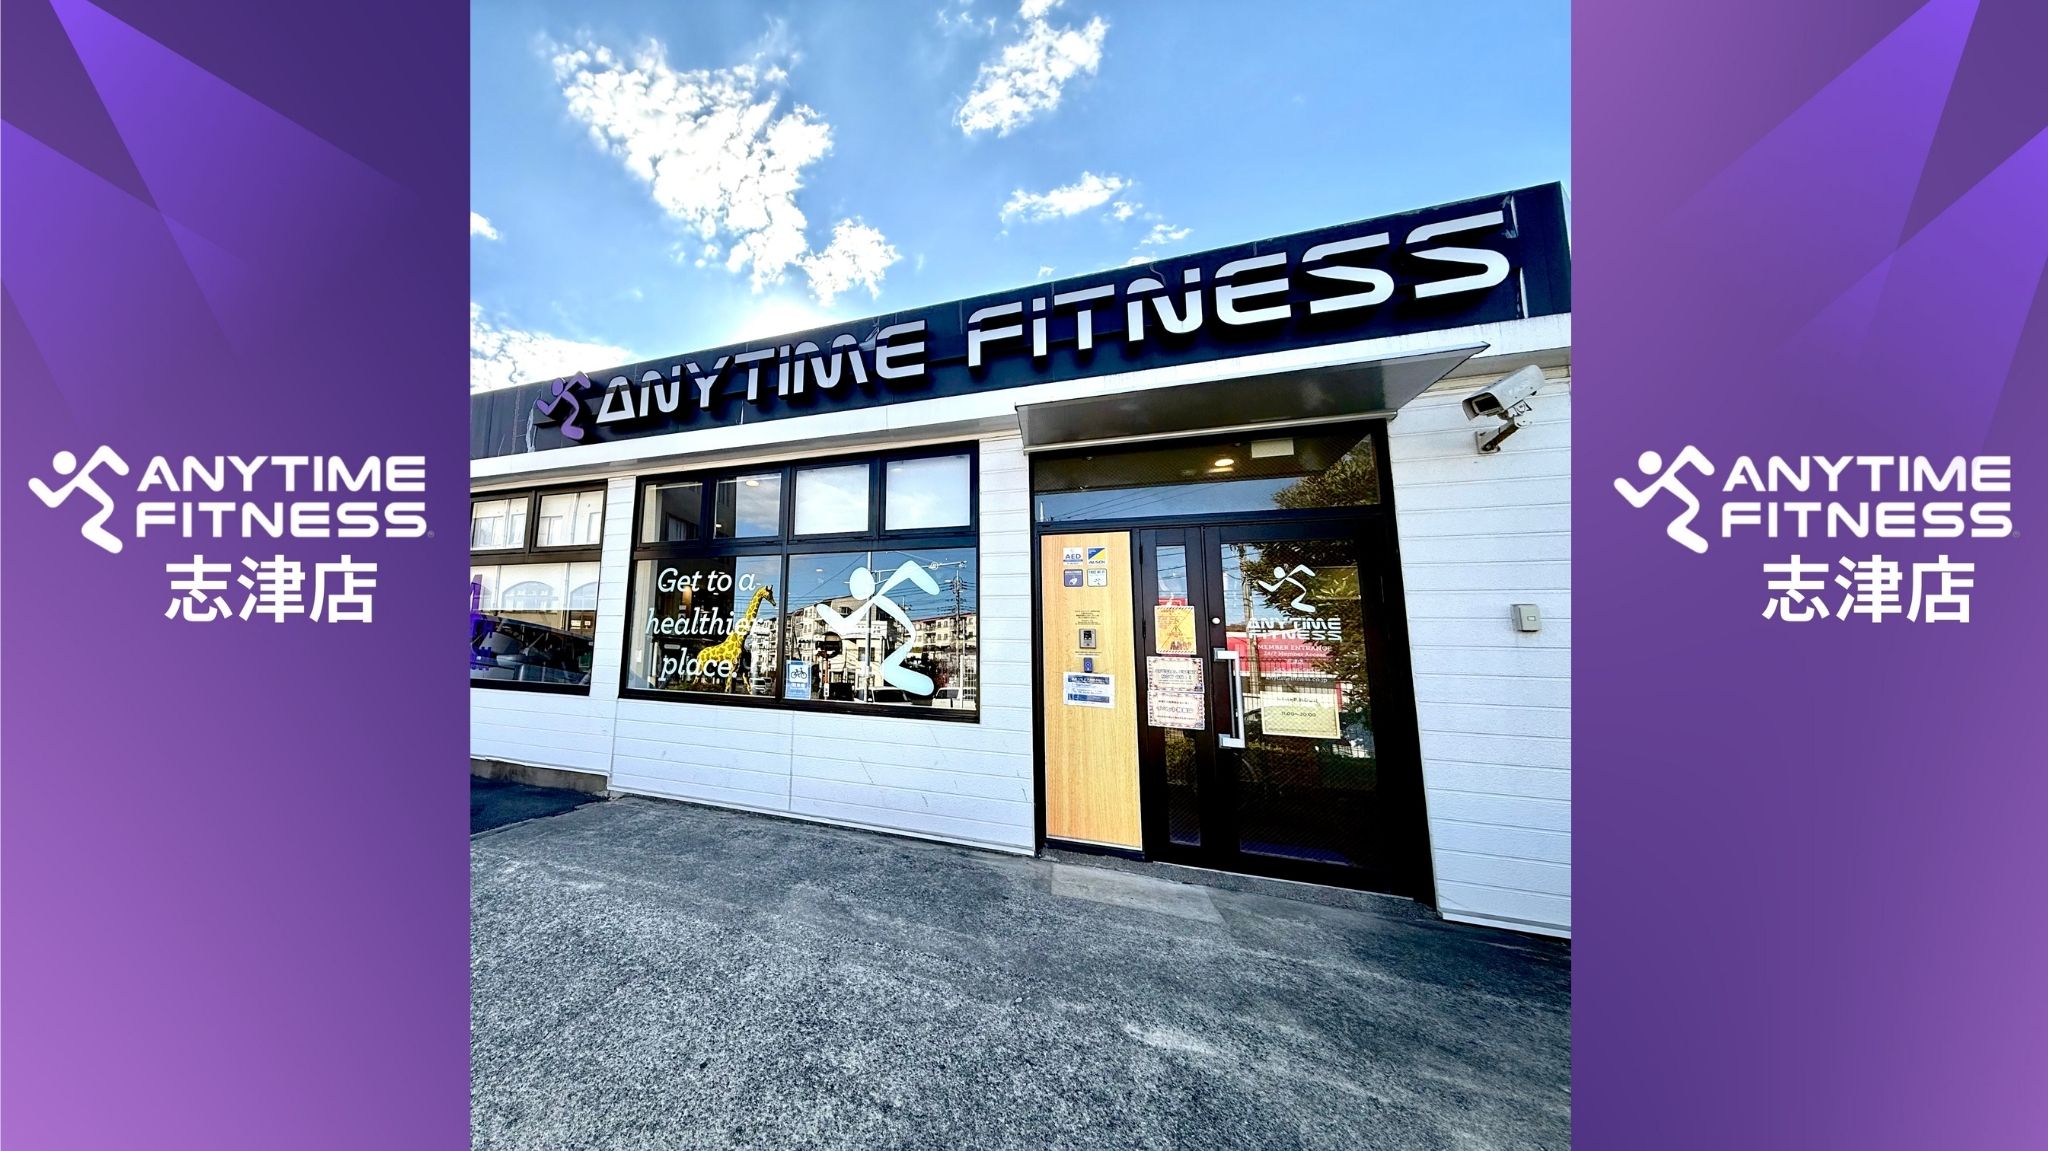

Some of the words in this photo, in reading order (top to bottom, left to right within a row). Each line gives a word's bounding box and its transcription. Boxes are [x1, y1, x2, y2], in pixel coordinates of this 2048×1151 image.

[595, 319, 926, 424] ANYTIME
[967, 210, 1511, 367] FITNESS
[657, 567, 702, 593] Get
[707, 570, 733, 592] to
[738, 573, 757, 592] a
[645, 606, 764, 636] healthier
[1247, 617, 1341, 630] ANYTIME
[1248, 630, 1342, 641] FITNESS
[1291, 644, 1332, 652] ENTRANCE
[658, 648, 738, 682] place.
